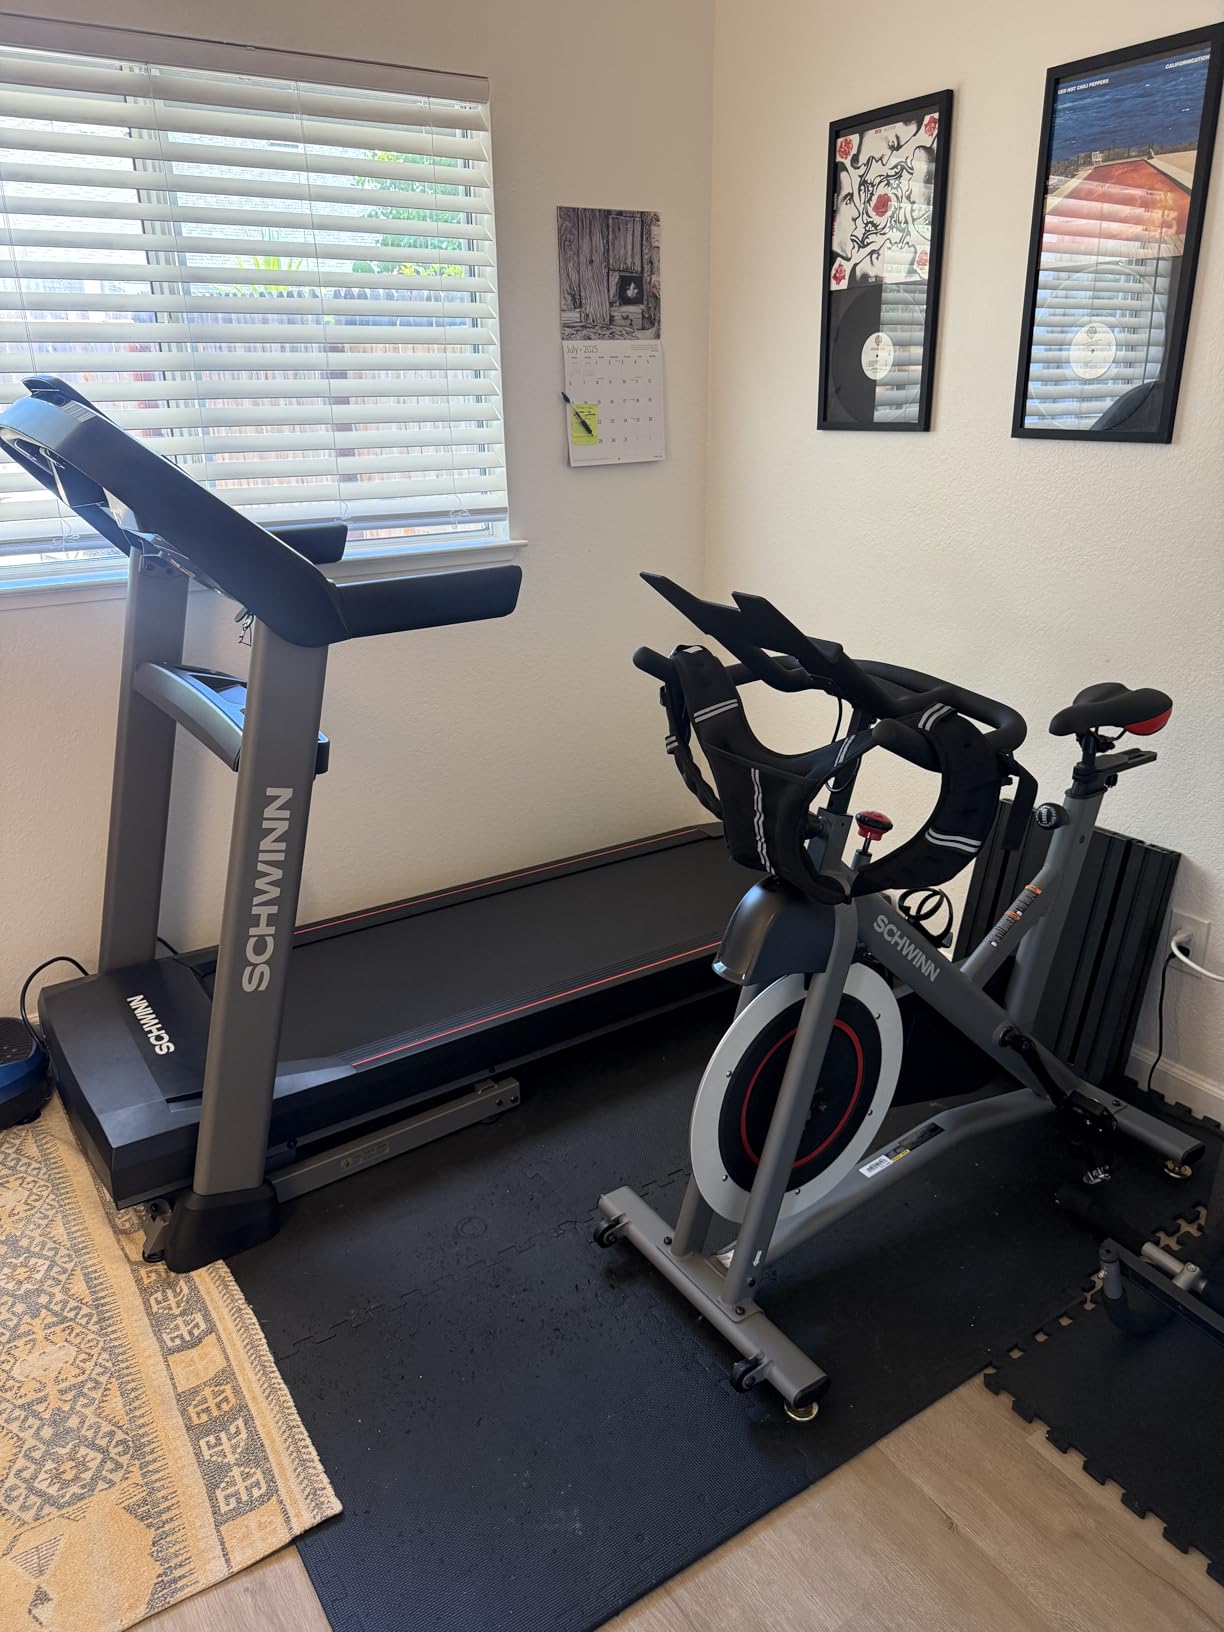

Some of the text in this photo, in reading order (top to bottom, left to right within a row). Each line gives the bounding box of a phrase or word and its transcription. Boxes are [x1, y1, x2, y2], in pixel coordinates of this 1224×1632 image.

[566, 344, 599, 355] July 2025
[241, 787, 294, 993] SCHWINN
[873, 914, 940, 982] SCHWINN
[126, 994, 175, 1055] SCHWINN
